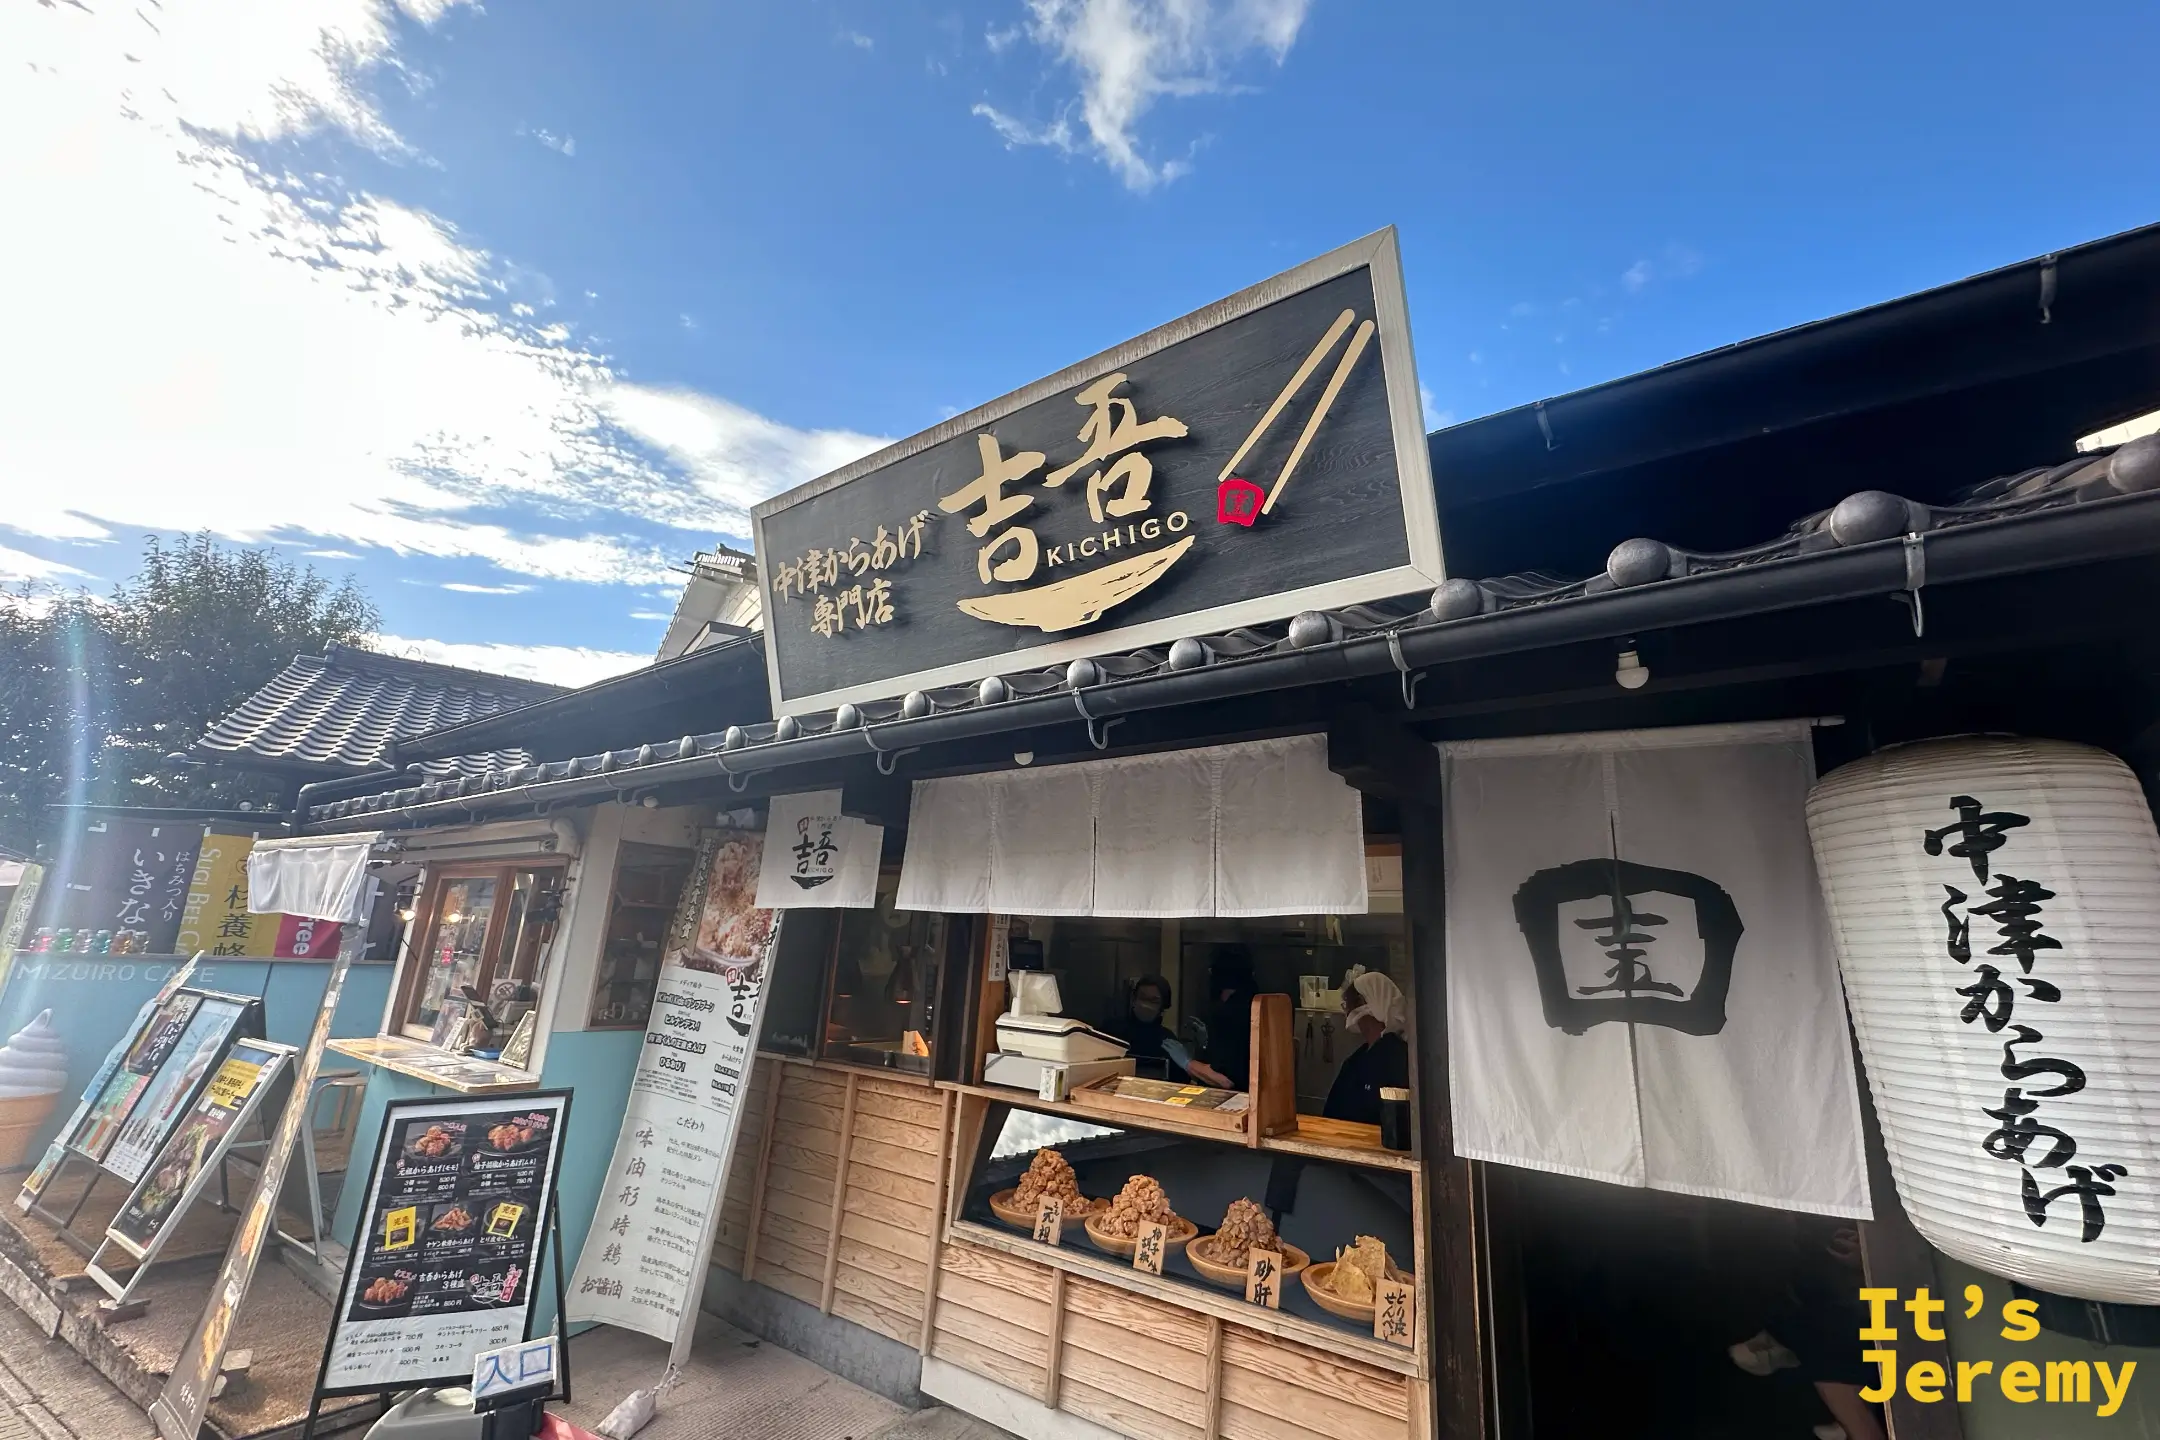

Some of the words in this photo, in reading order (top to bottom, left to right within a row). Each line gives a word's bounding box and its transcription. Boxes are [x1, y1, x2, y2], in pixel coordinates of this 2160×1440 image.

[773, 509, 929, 604] 中津からあげ
[1046, 511, 1189, 568] KICHIGO
[811, 577, 895, 638] 専門店
[193, 848, 221, 887] SUGI
[116, 848, 164, 933] いきな
[160, 851, 191, 922] はちみつ入り
[182, 893, 211, 925] BEE
[292, 918, 319, 955] ree
[17, 963, 135, 982] MIZUIRO
[1923, 795, 2129, 1243] 中津からあげ
[635, 1127, 654, 1148] 味
[676, 1117, 705, 1133] こだわり
[626, 1157, 646, 1178] 油
[502, 1206, 518, 1216] 完売
[619, 1186, 640, 1207] 形
[610, 1214, 631, 1236] 時
[602, 1242, 622, 1266] 鶏
[580, 1276, 623, 1299] お醤油
[1254, 1257, 1276, 1306] 砂肝
[1394, 1288, 1408, 1337] とり皮
[476, 1344, 551, 1394] 入口
